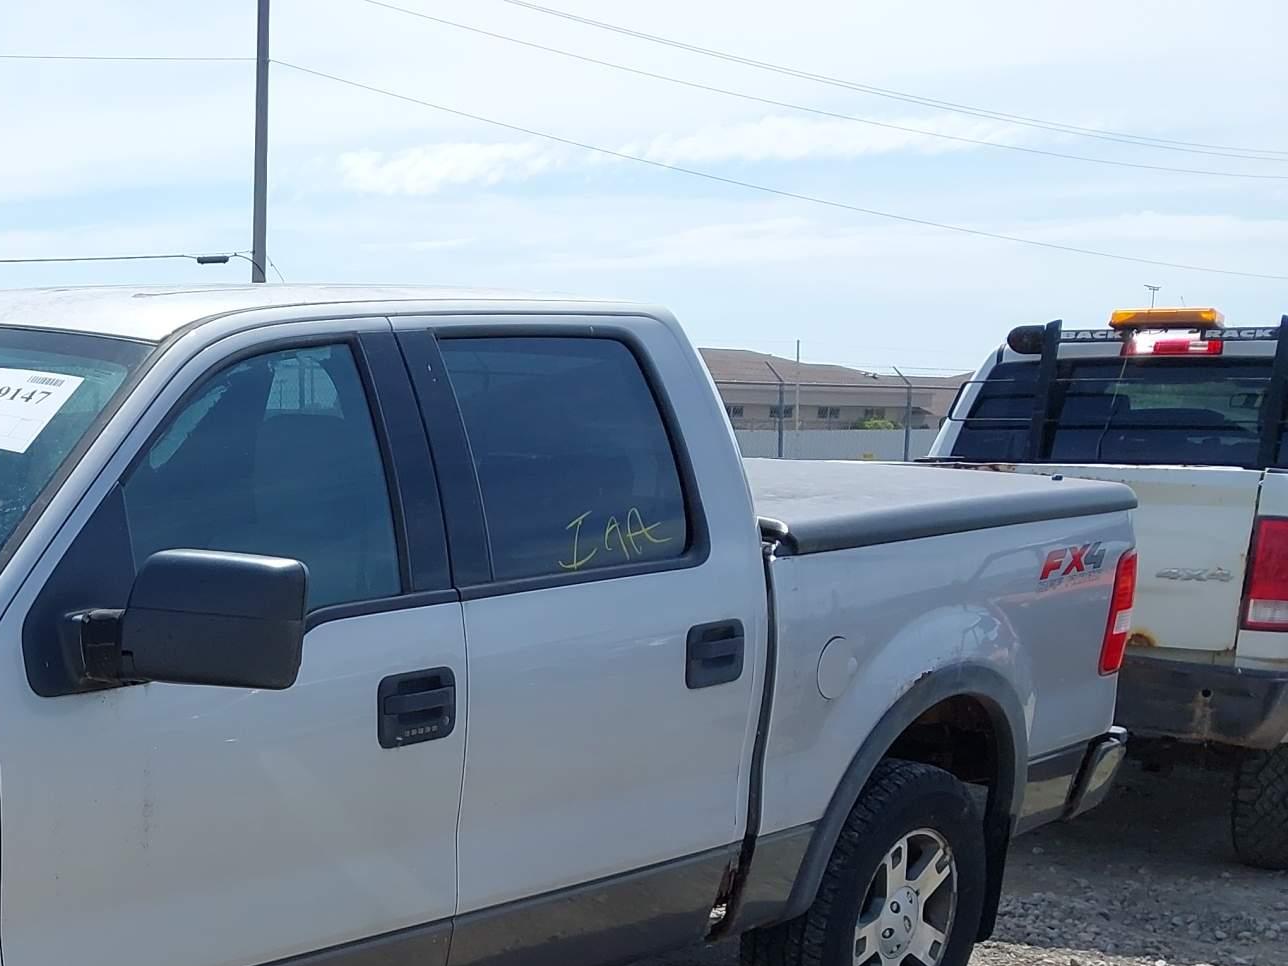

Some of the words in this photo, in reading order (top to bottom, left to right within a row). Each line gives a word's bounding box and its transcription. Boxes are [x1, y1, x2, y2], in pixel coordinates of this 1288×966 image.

[1060, 331, 1124, 340] BACK
[1205, 329, 1275, 339] RACK
[558, 507, 673, 570] IAA
[1039, 541, 1106, 580] FX4
